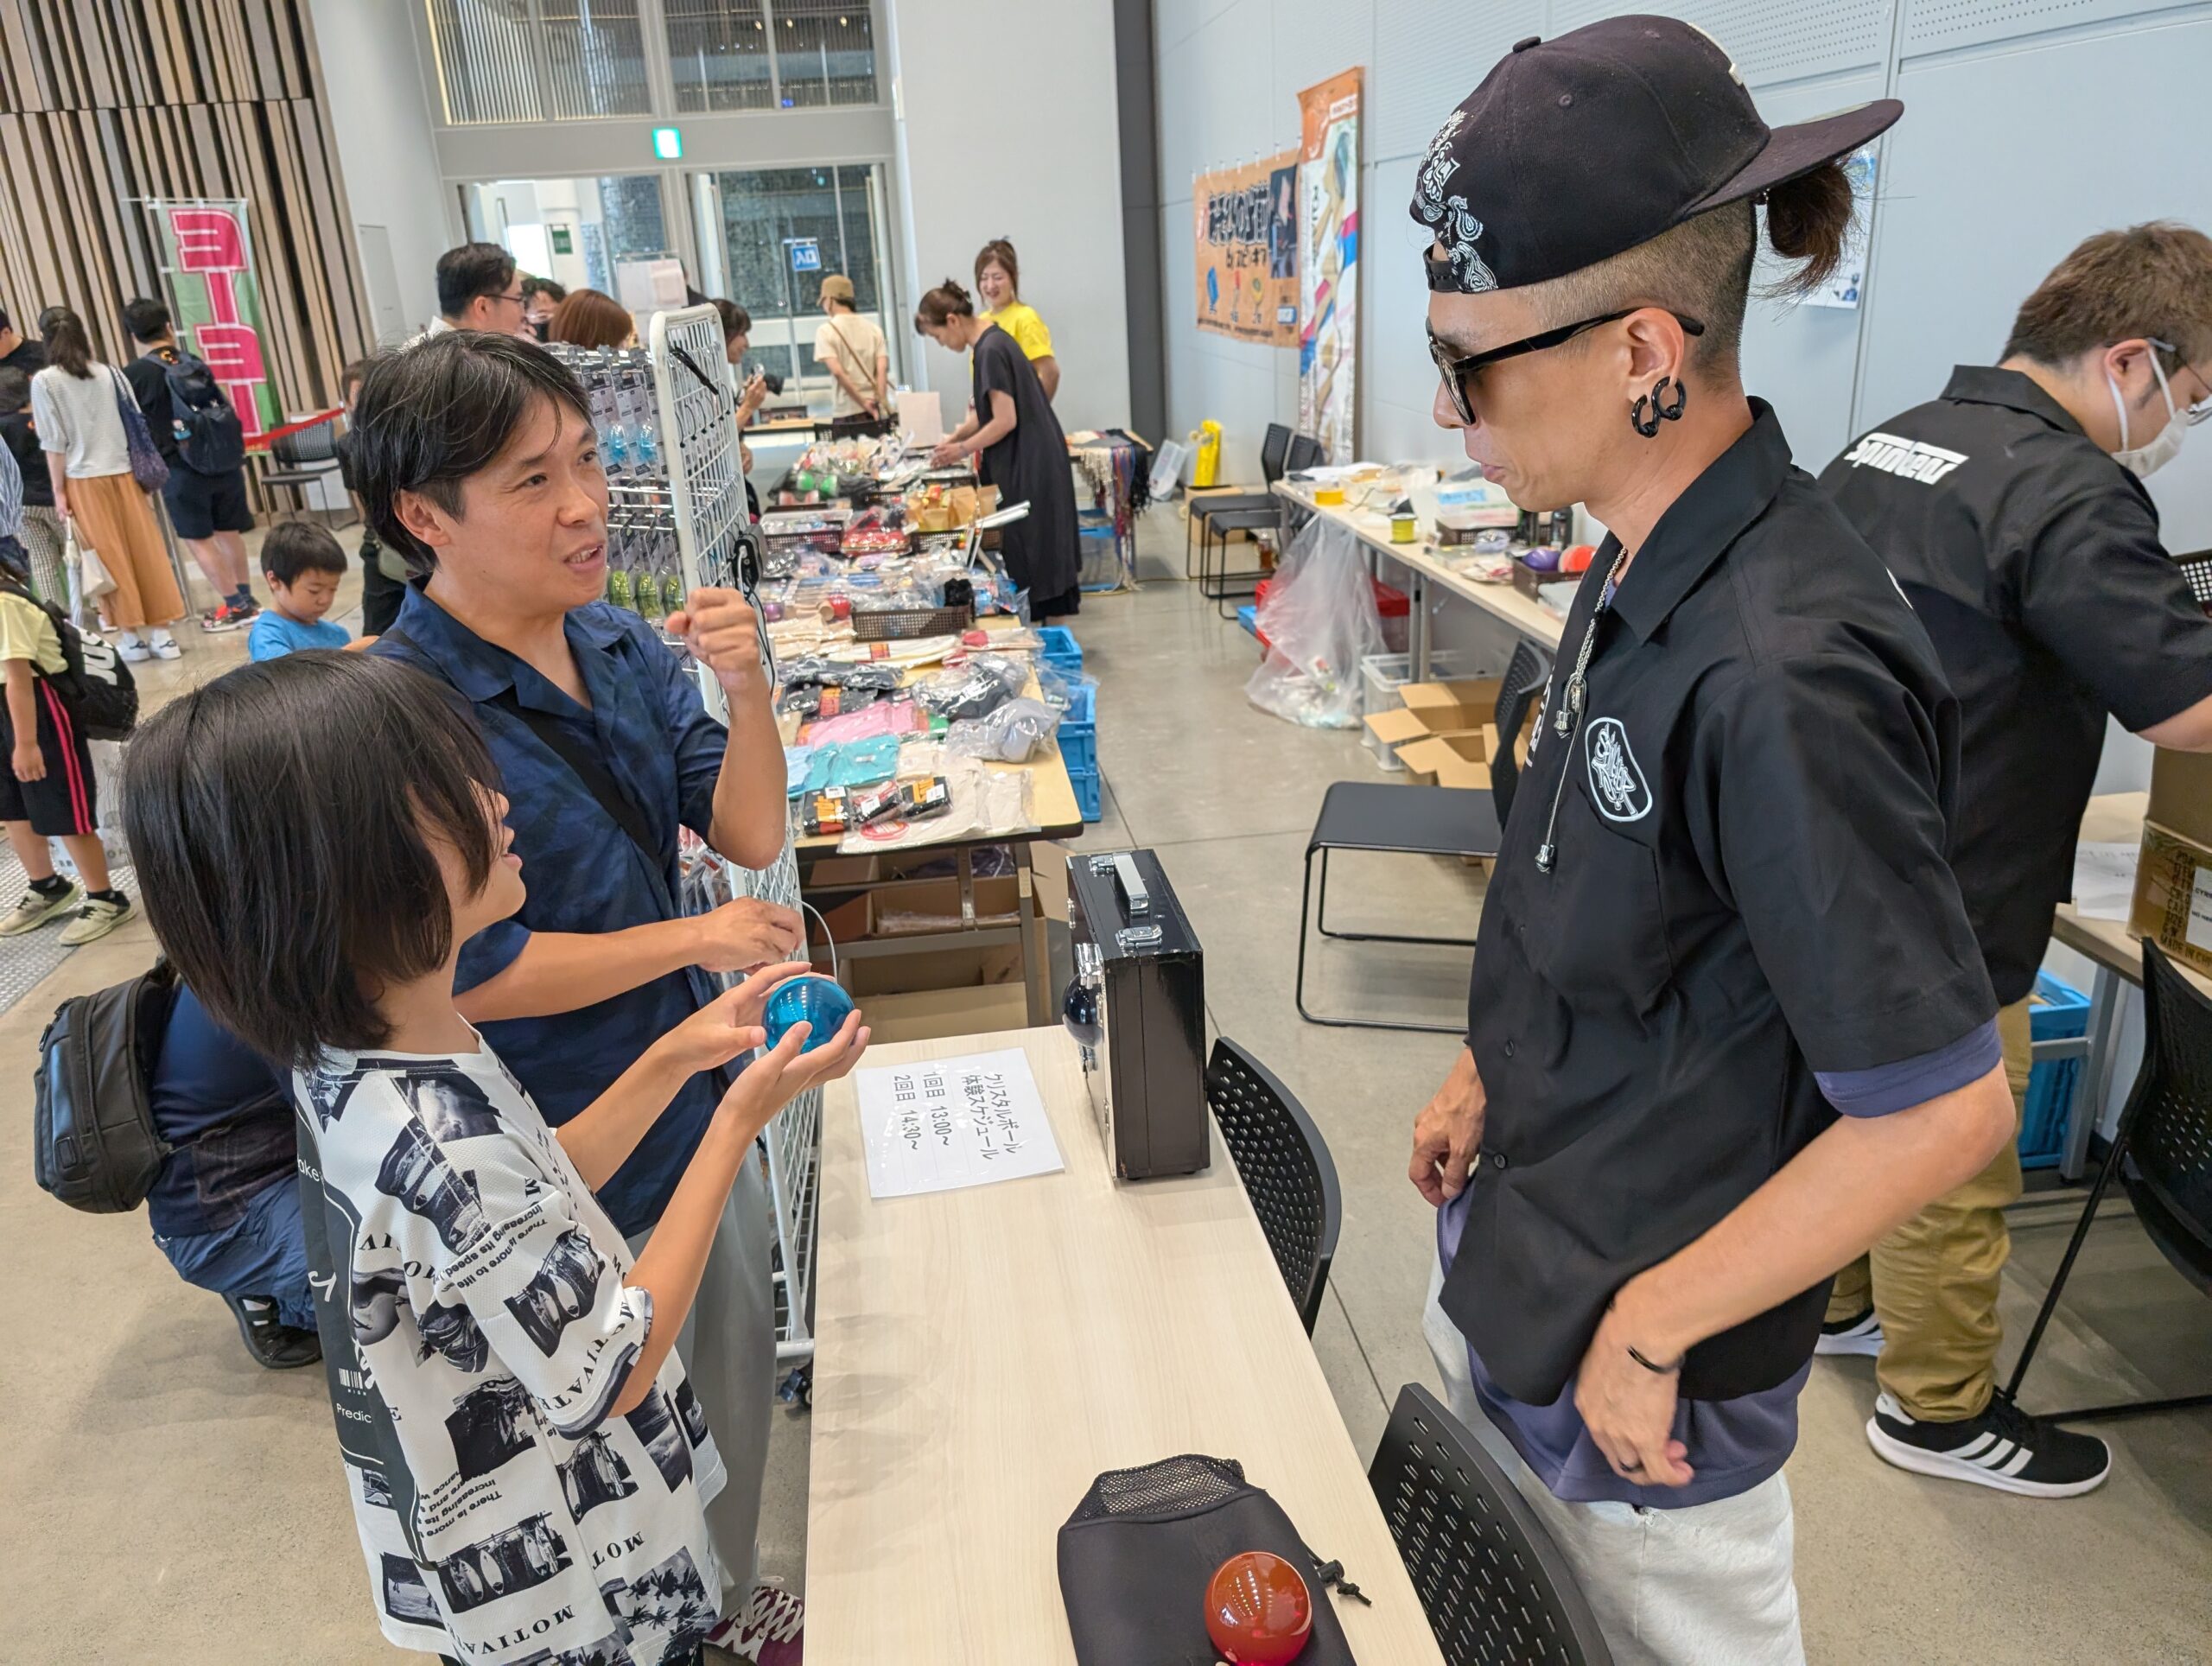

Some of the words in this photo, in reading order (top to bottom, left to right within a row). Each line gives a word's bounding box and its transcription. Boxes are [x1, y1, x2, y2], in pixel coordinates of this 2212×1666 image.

[170, 208, 267, 437] ヨーヨー
[893, 1074, 916, 1102] 2回目
[923, 1071, 945, 1098] 1回目
[961, 1075, 999, 1160] 体験スケジュール
[984, 1073, 1021, 1154] クリスタルボール
[518, 1219, 548, 1239] There
[476, 1266, 489, 1276] to
[457, 1275, 476, 1288] life
[336, 1402, 372, 1423] Predic
[429, 1494, 448, 1512] and
[442, 1479, 496, 1517] increasing
[469, 1491, 502, 1510] There
[424, 1516, 439, 1524] its
[457, 1509, 467, 1518] is
[427, 1517, 454, 1536] more
